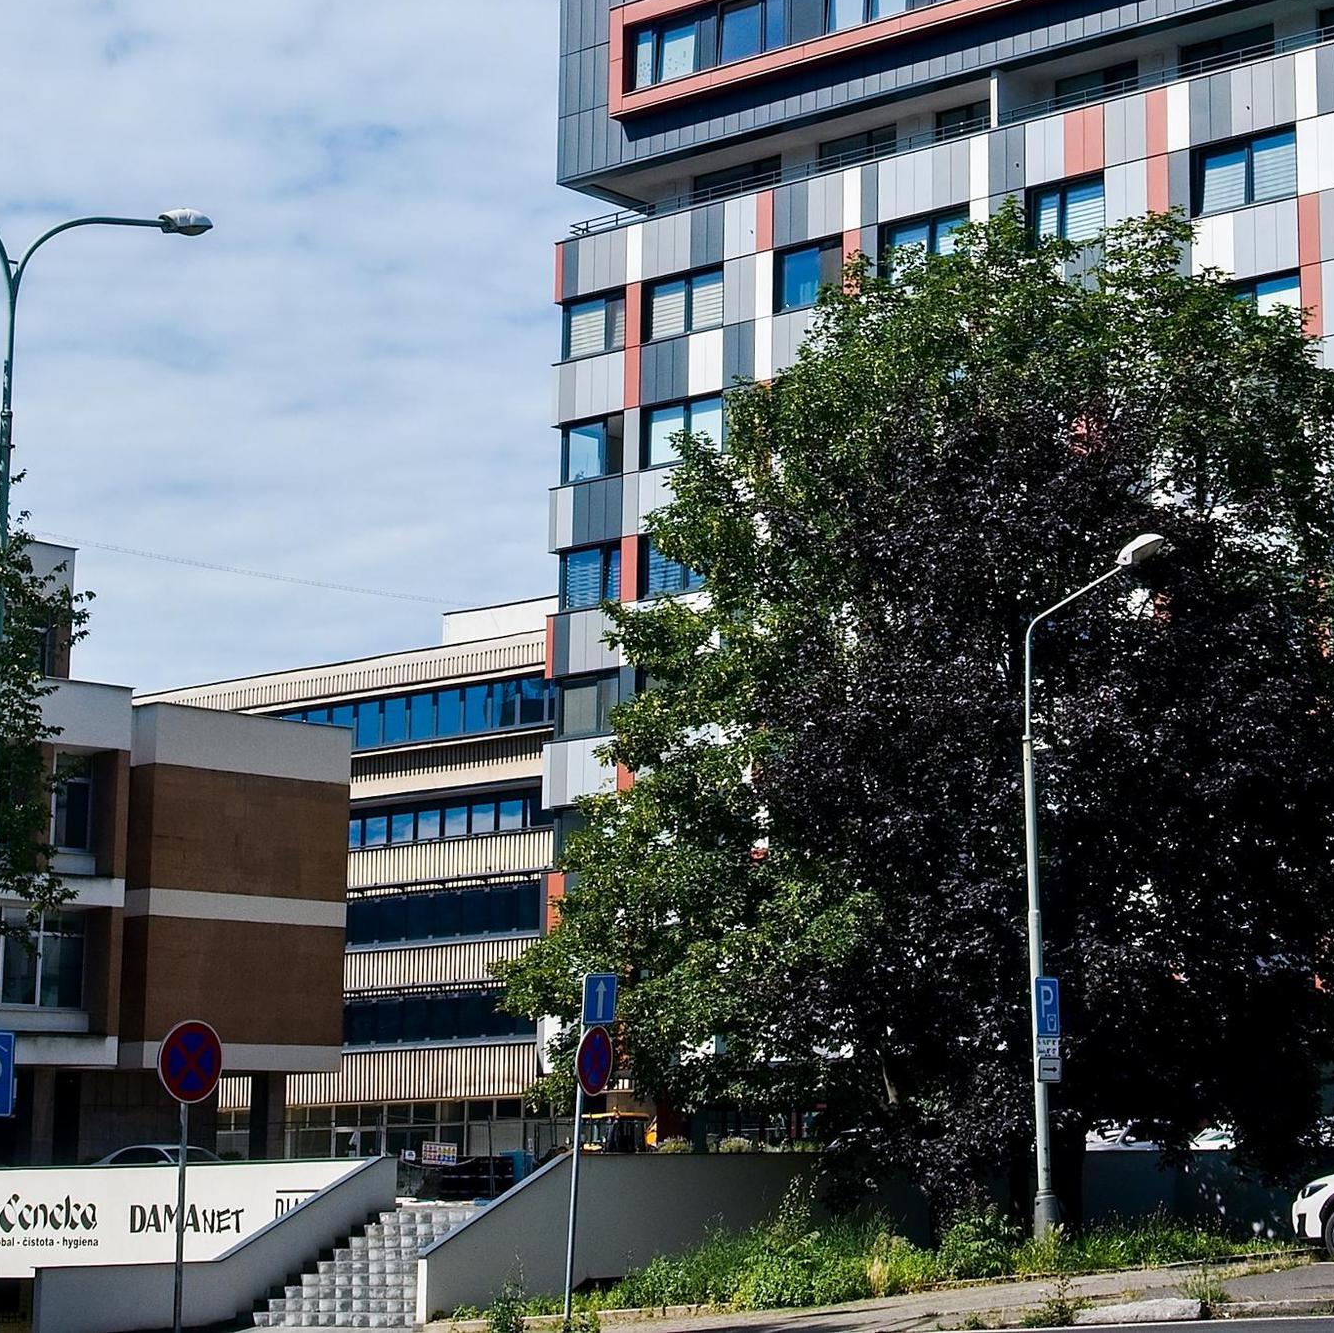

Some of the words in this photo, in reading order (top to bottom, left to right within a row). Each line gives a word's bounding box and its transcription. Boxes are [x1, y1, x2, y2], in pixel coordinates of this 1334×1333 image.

[1040, 985, 1054, 1019] P
[129, 1204, 245, 1234] DAMANET
[22, 1236, 55, 1247] čistota
[62, 1236, 99, 1249] hygiena
